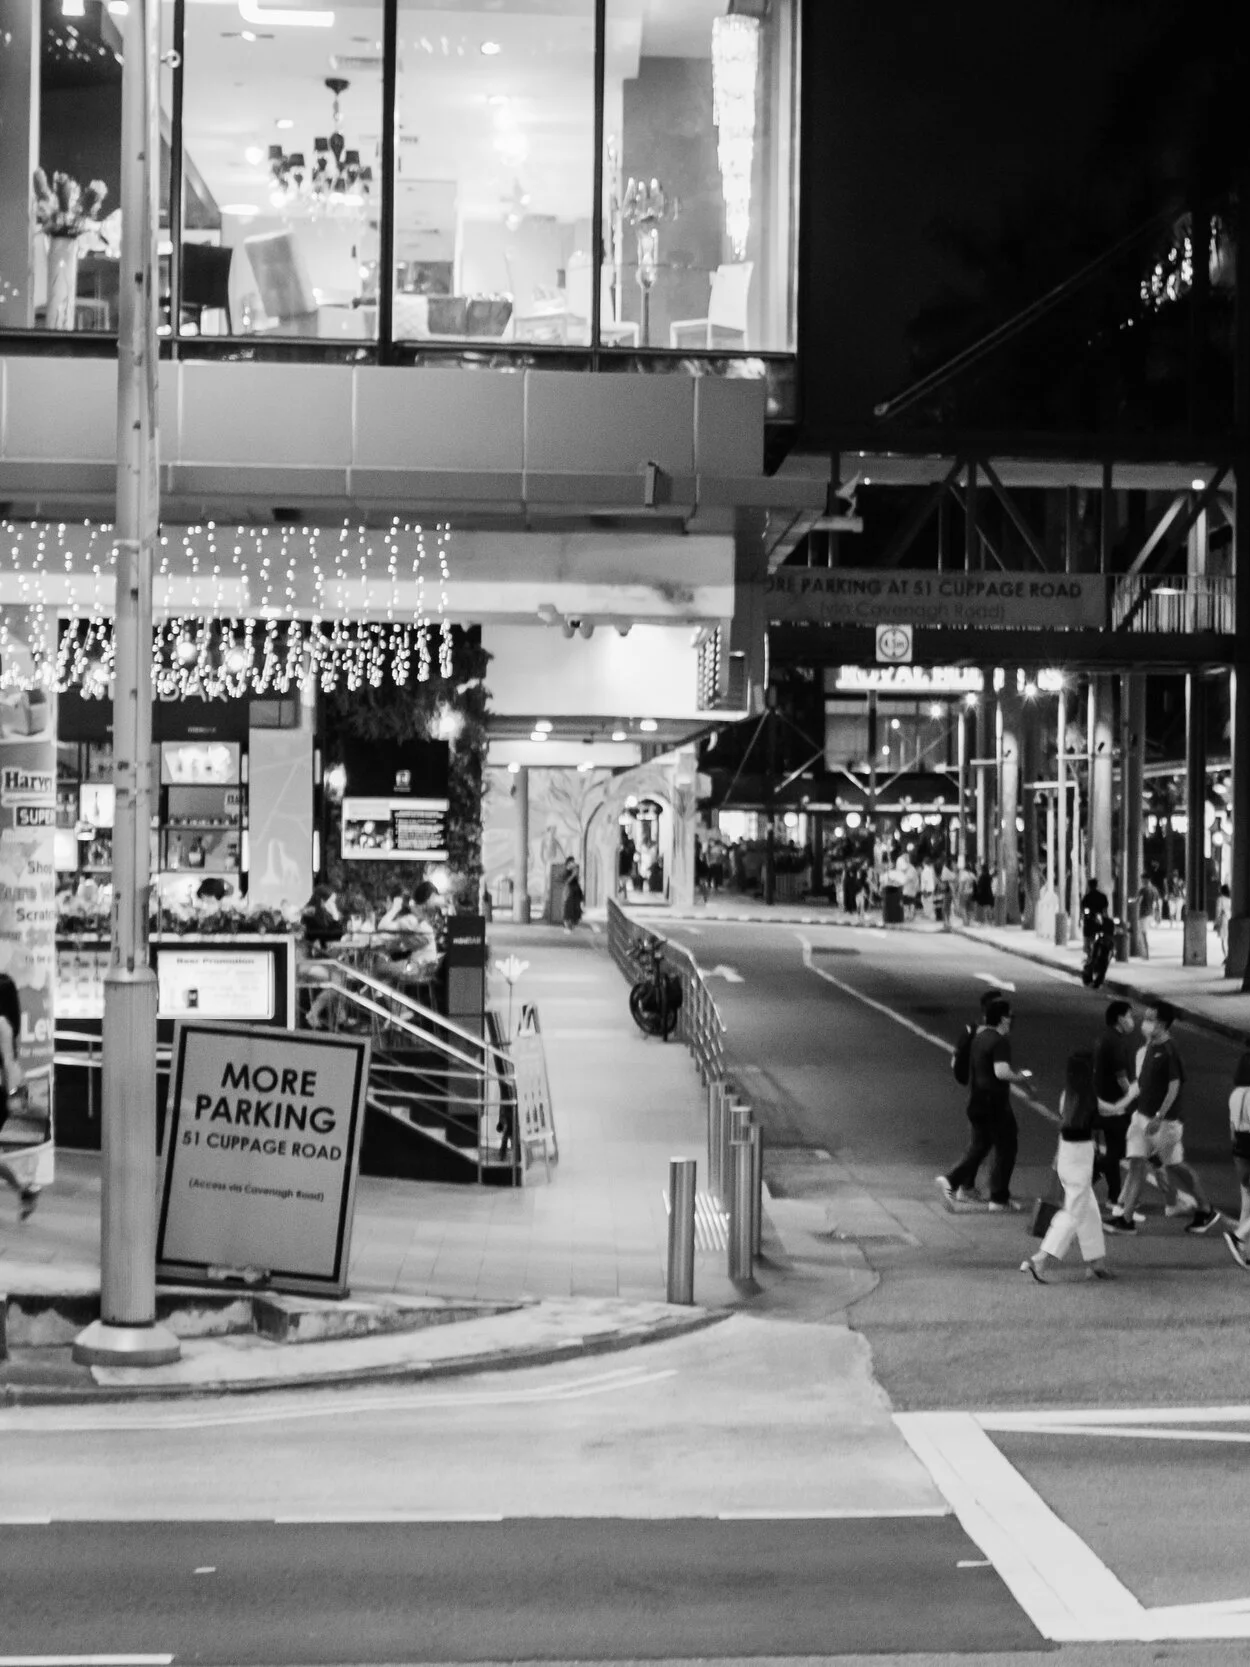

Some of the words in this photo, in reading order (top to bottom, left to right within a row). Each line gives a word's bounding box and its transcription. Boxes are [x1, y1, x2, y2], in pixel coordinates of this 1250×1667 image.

[802, 577, 883, 595] PARKING
[888, 579, 908, 595] AT
[913, 580, 931, 596] 51
[938, 581, 1025, 597] CUPPAGE
[1029, 582, 1082, 598] ROAD
[221, 1062, 317, 1098] MORE
[195, 1094, 336, 1134] PARKING
[182, 1130, 200, 1146] 51
[206, 1132, 287, 1156] CUPPAGE
[292, 1141, 342, 1161] ROAD
